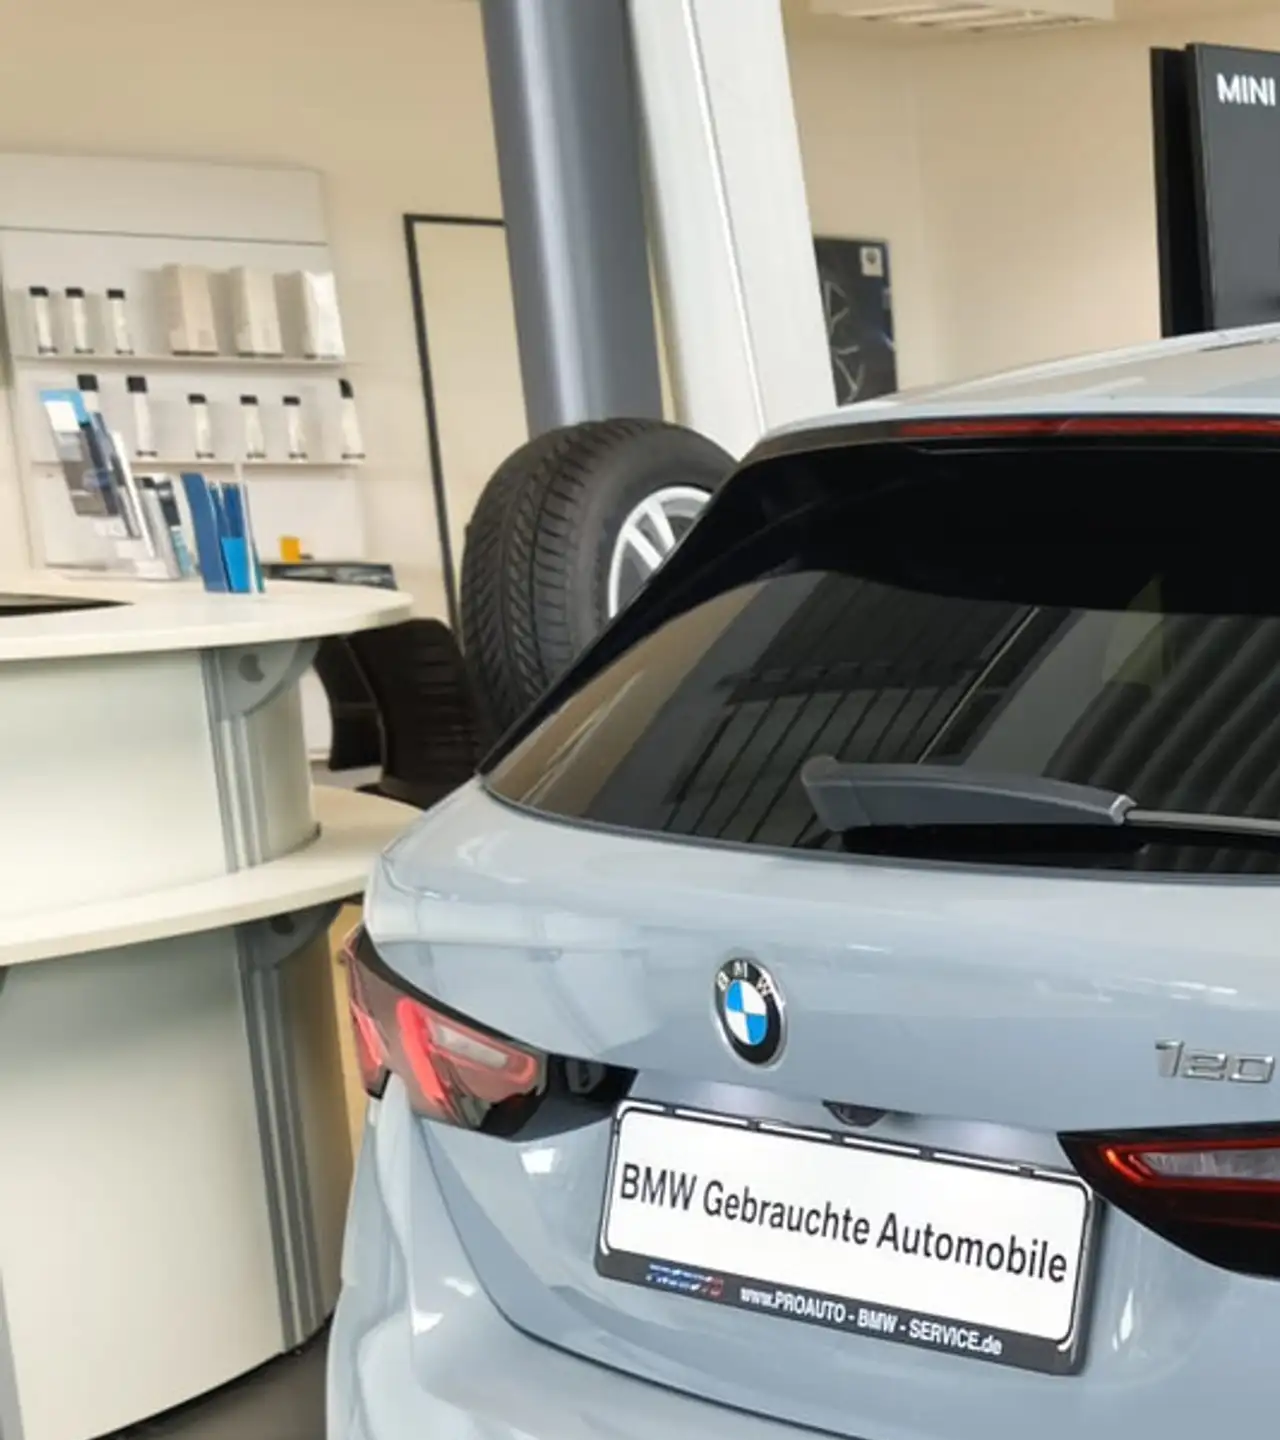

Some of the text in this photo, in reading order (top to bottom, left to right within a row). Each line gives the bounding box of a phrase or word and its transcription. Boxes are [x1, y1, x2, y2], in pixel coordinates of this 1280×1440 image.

[1216, 73, 1276, 107] MINI
[717, 961, 771, 998] BMW
[1155, 1038, 1275, 1084] 120
[620, 1162, 1067, 1284] BMW Gebrauchte Automobile
[740, 1286, 846, 1324] www.PROAUTO
[857, 1308, 898, 1334] BMW
[909, 1318, 1003, 1356] SERVICE.de
